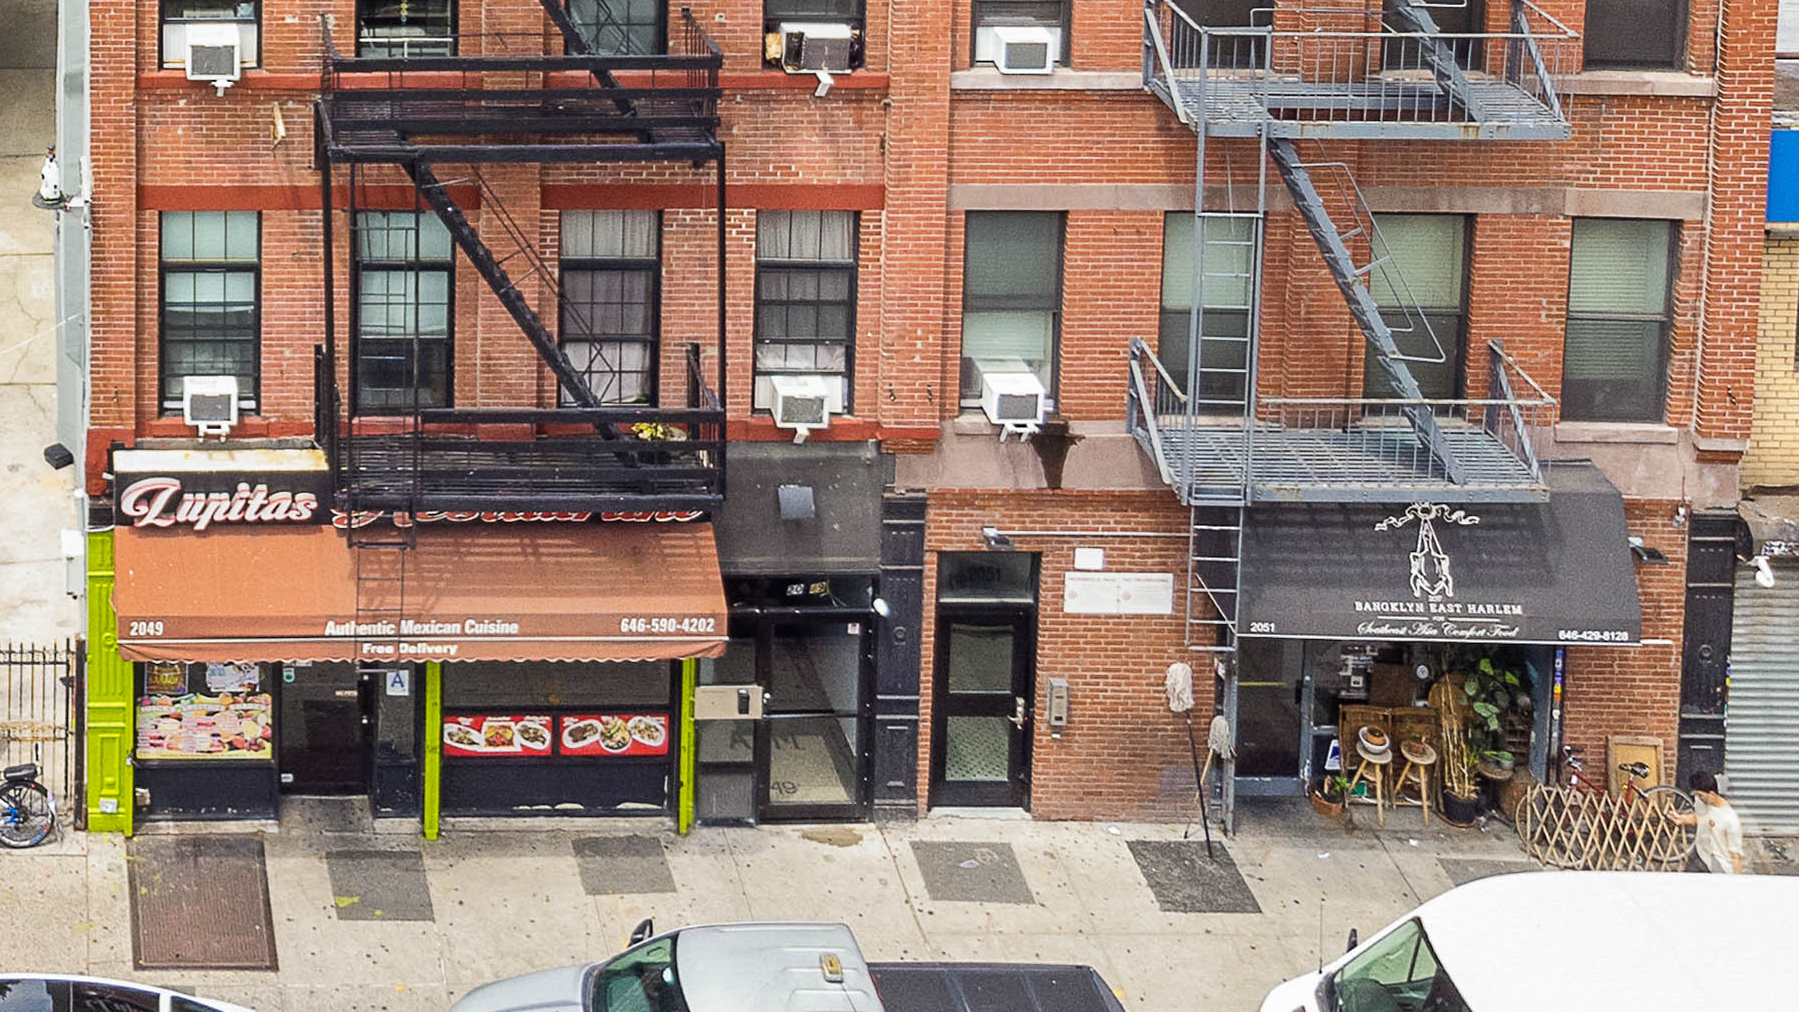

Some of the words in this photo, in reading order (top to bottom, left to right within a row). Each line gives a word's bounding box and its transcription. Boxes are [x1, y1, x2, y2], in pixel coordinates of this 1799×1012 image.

[120, 476, 318, 531] Lupitas
[1430, 603, 1462, 614] EAST
[1468, 604, 1523, 615] HARLEM
[129, 621, 164, 636] 2049
[324, 620, 395, 636] Authentic
[400, 620, 461, 635] Mexican
[465, 619, 519, 635] Cuisine
[620, 618, 715, 633] 646-590-4202
[1251, 621, 1276, 633] 2051
[1486, 624, 1520, 637] Food
[362, 643, 394, 655] Free
[399, 642, 458, 655] Delivery
[390, 671, 405, 689] A
